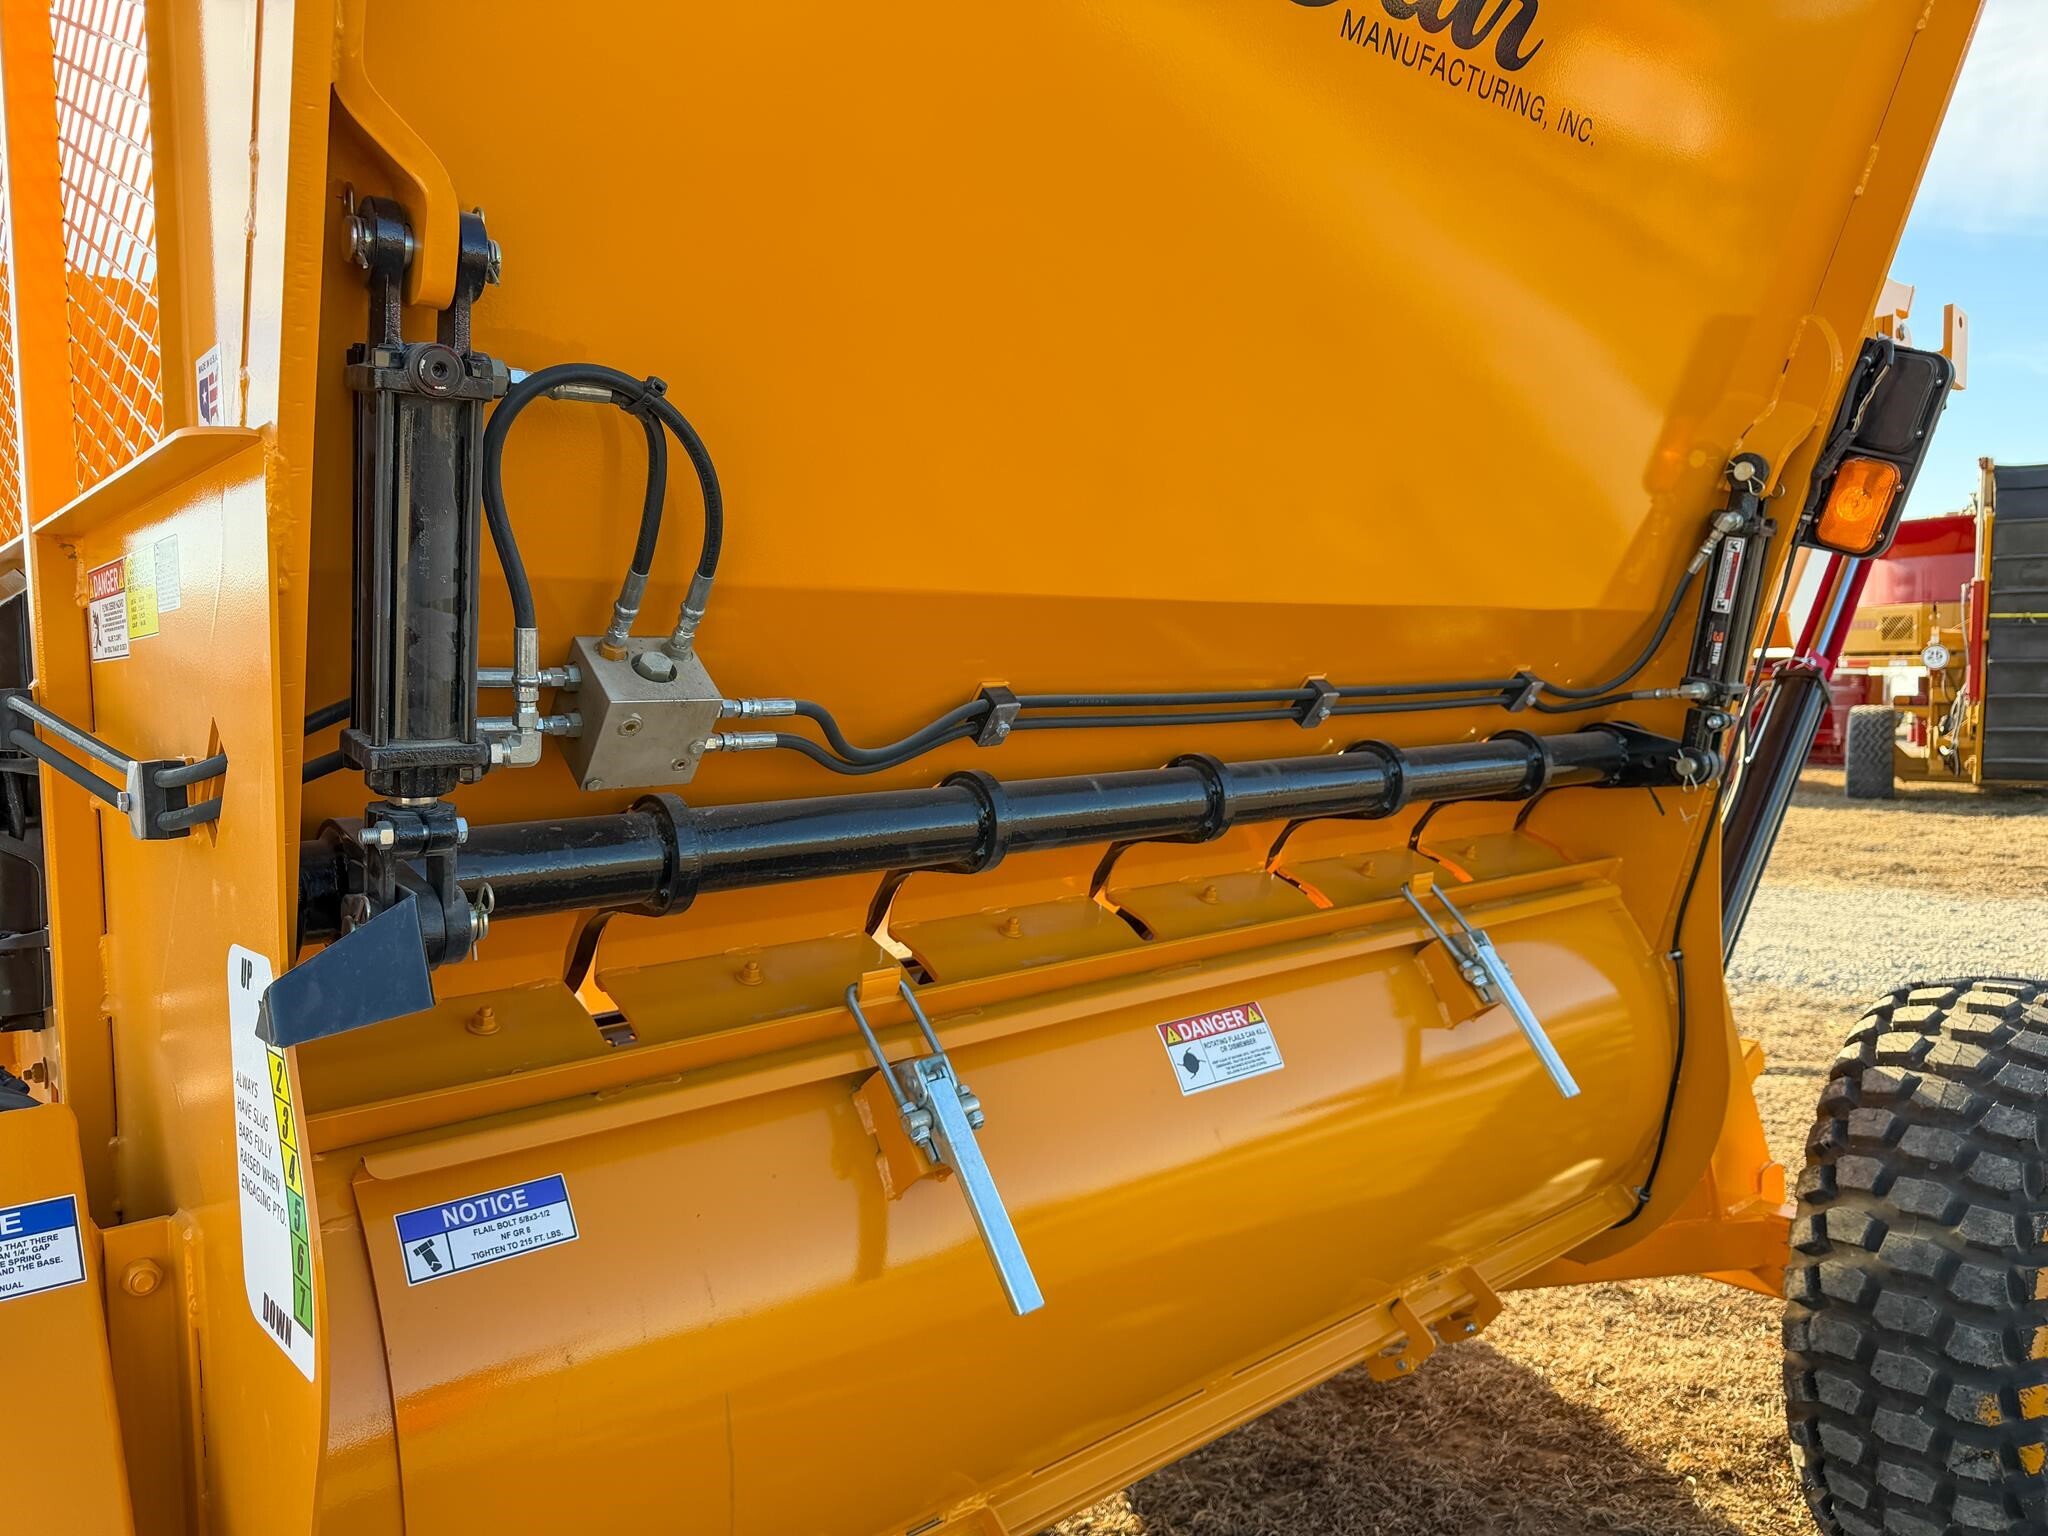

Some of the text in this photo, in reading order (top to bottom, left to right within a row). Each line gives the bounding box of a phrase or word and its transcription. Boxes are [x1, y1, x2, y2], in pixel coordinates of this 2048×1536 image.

[1340, 8, 1547, 130] MANUFACTURING,
[1557, 107, 1593, 147] INC.
[93, 567, 119, 598] DANGER
[240, 956, 253, 991] UP
[1177, 1009, 1248, 1041] DANGER
[1203, 1037, 1228, 1048] ROTATING
[1228, 1032, 1245, 1042] FLAILS
[1245, 1030, 1256, 1038] CAN
[235, 1070, 259, 1098] ALWAYS
[275, 1061, 282, 1094] 2
[237, 1095, 269, 1132] HAVE SLUG
[281, 1106, 289, 1140] 3
[238, 1121, 273, 1160] BARS FULLY
[239, 1147, 281, 1194] RAISED WHEN
[288, 1154, 295, 1187] 4
[241, 1173, 287, 1226] ENGAGING PTO.
[294, 1199, 301, 1232] 5
[441, 1188, 529, 1228] NOTICE
[473, 1209, 550, 1236] FLAIL BOLT 5/8x3-1/2
[500, 1231, 512, 1241] NF
[512, 1227, 525, 1237] GR
[5, 1239, 27, 1251] THAT
[29, 1233, 59, 1245] THERE
[31, 1243, 50, 1253] GAP
[472, 1229, 564, 1260] TIGHTEN TO 215 FT. LBS.
[8, 1253, 42, 1266] SPRING
[17, 1262, 35, 1272] THE
[36, 1255, 63, 1268] BASE.
[297, 1243, 304, 1276] 6
[299, 1287, 306, 1318] 7
[262, 1290, 292, 1349] DOWN
